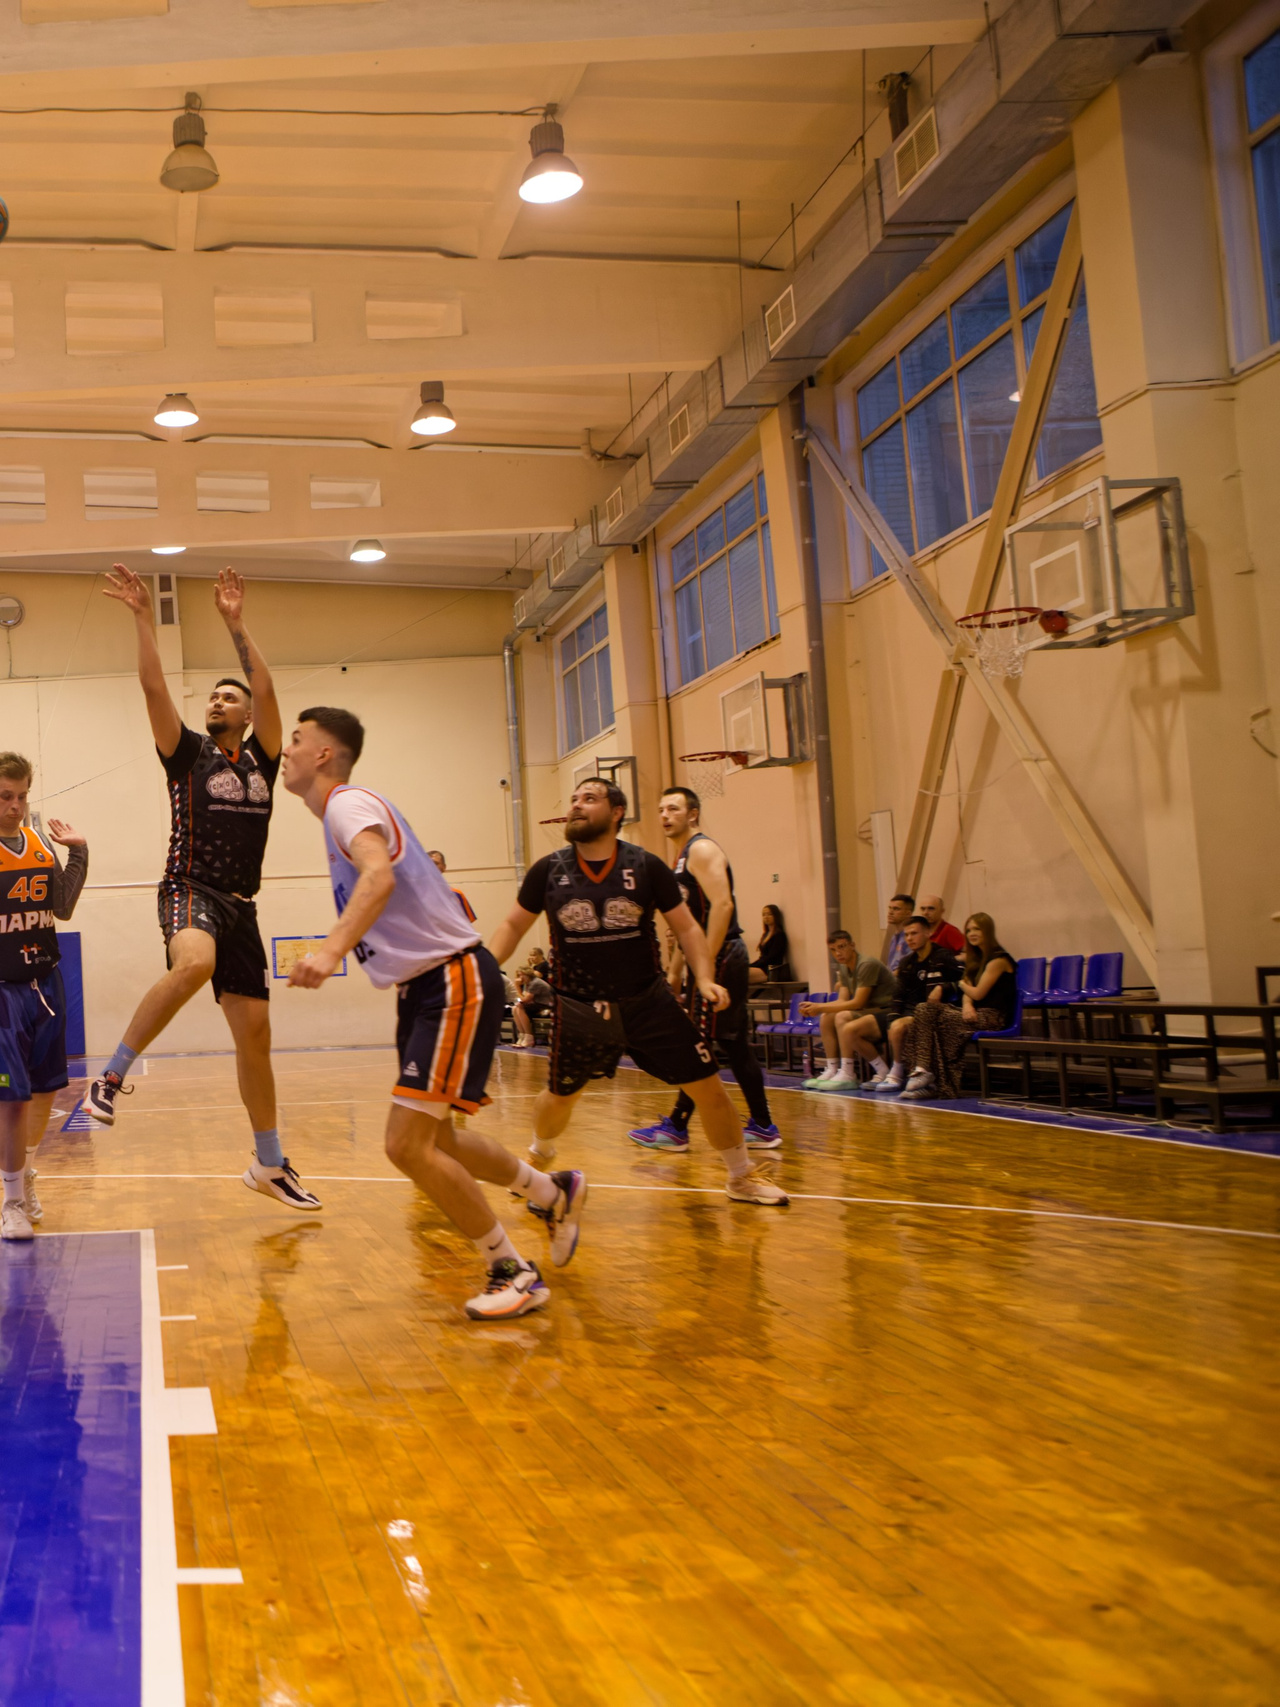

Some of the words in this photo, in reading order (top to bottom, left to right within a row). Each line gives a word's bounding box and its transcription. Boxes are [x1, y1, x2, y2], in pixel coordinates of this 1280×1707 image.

[7, 874, 49, 902] 46
[622, 868, 636, 890] 5
[694, 1041, 712, 1063] 5
